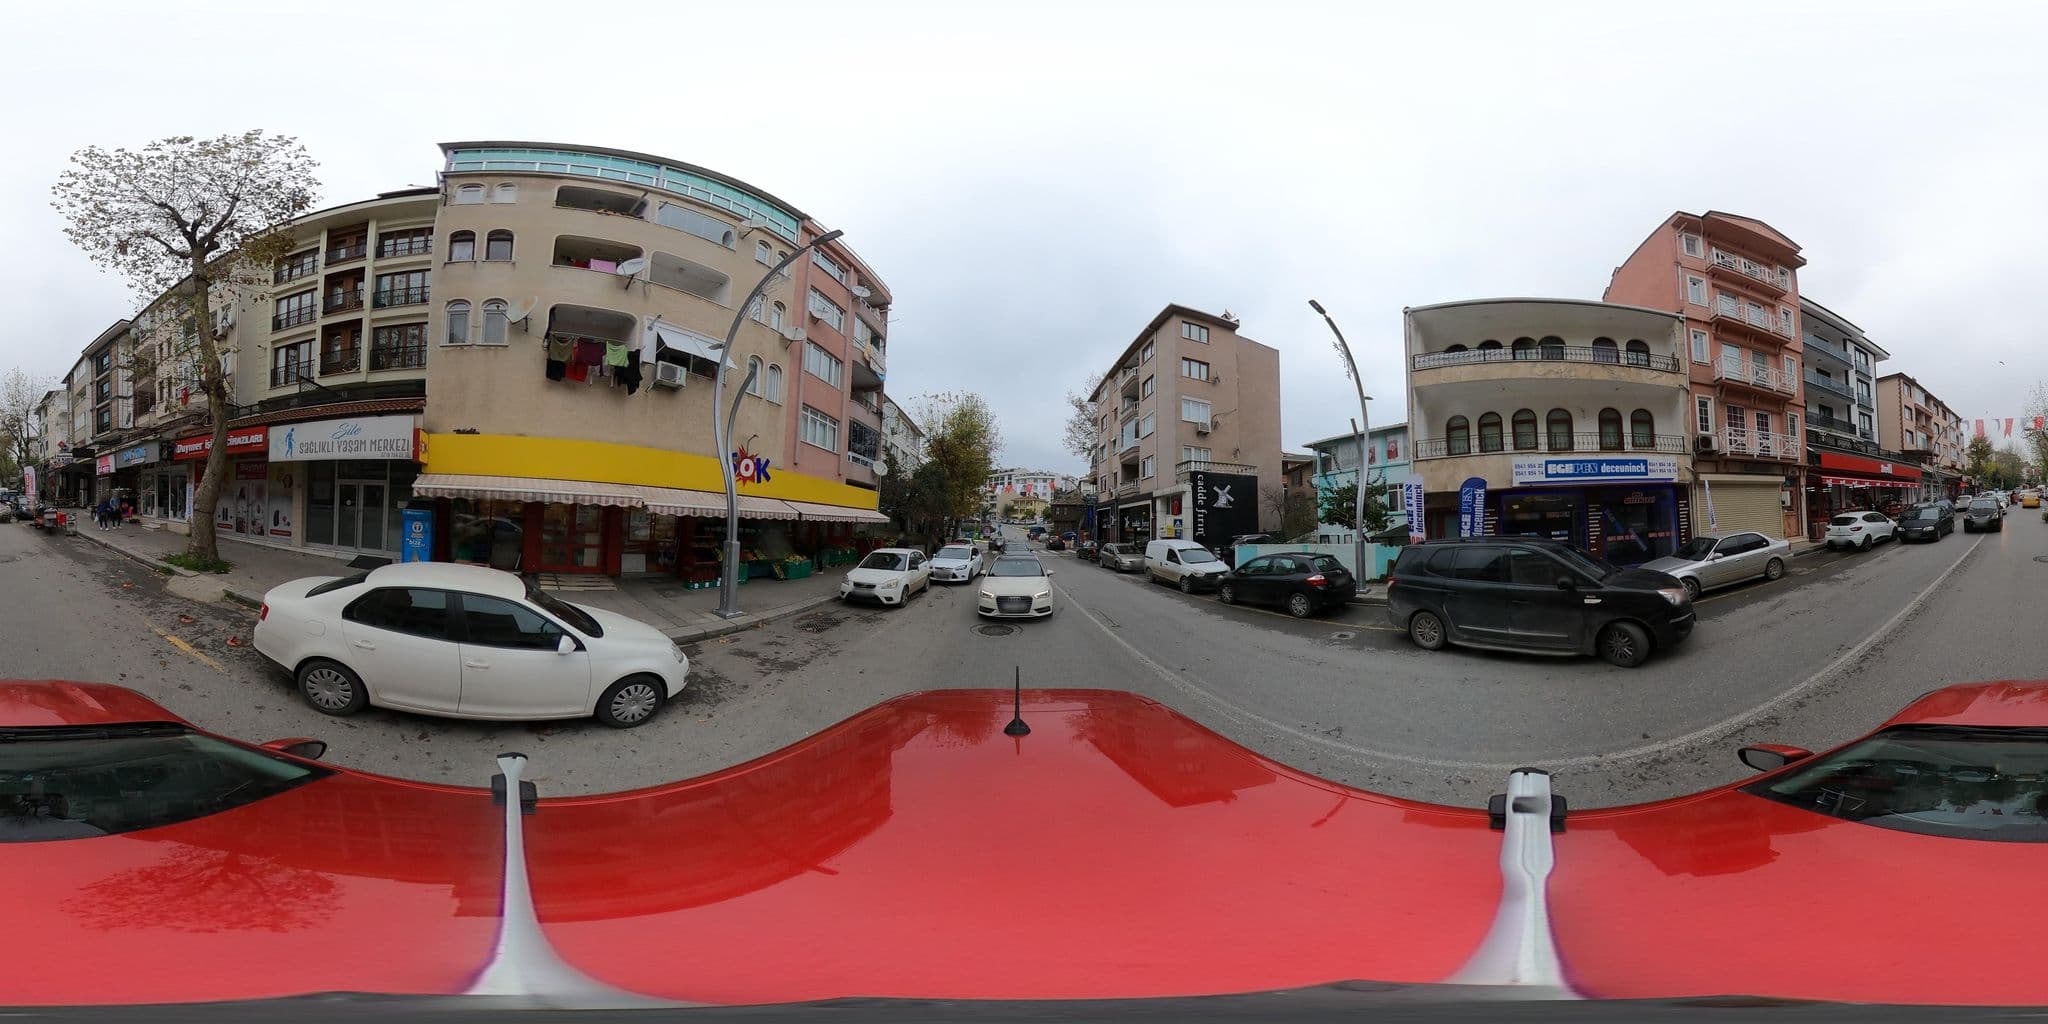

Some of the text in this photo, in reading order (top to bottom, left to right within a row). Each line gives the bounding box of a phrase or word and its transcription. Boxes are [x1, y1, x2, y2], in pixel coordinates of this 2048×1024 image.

[1600, 461, 1646, 473] deceuninck
[1197, 474, 1207, 506] cadde
[1414, 483, 1424, 533] deceuninck
